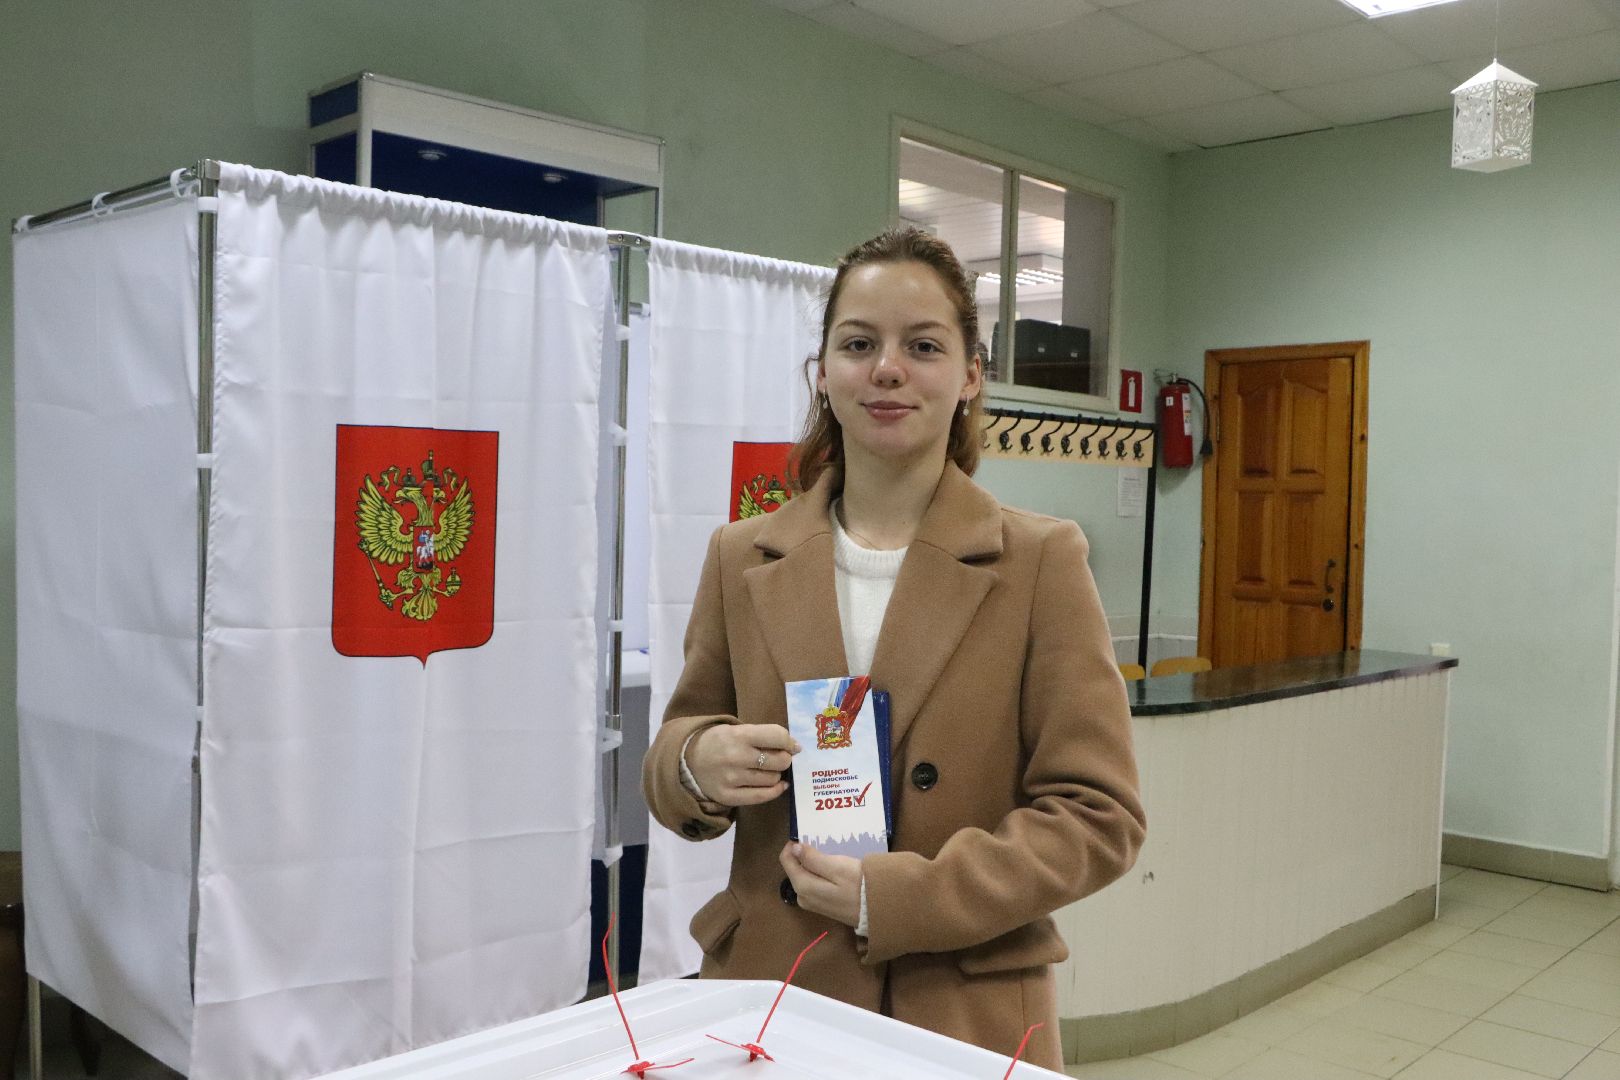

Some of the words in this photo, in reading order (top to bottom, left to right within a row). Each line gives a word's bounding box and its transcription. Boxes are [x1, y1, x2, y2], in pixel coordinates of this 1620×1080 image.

[812, 768, 849, 777] РОДНОЕ
[812, 775, 858, 783] ПОДМОСКОВЬЕ
[813, 788, 859, 796] ГУБЕРНАТОРА
[814, 796, 852, 810] 2023
